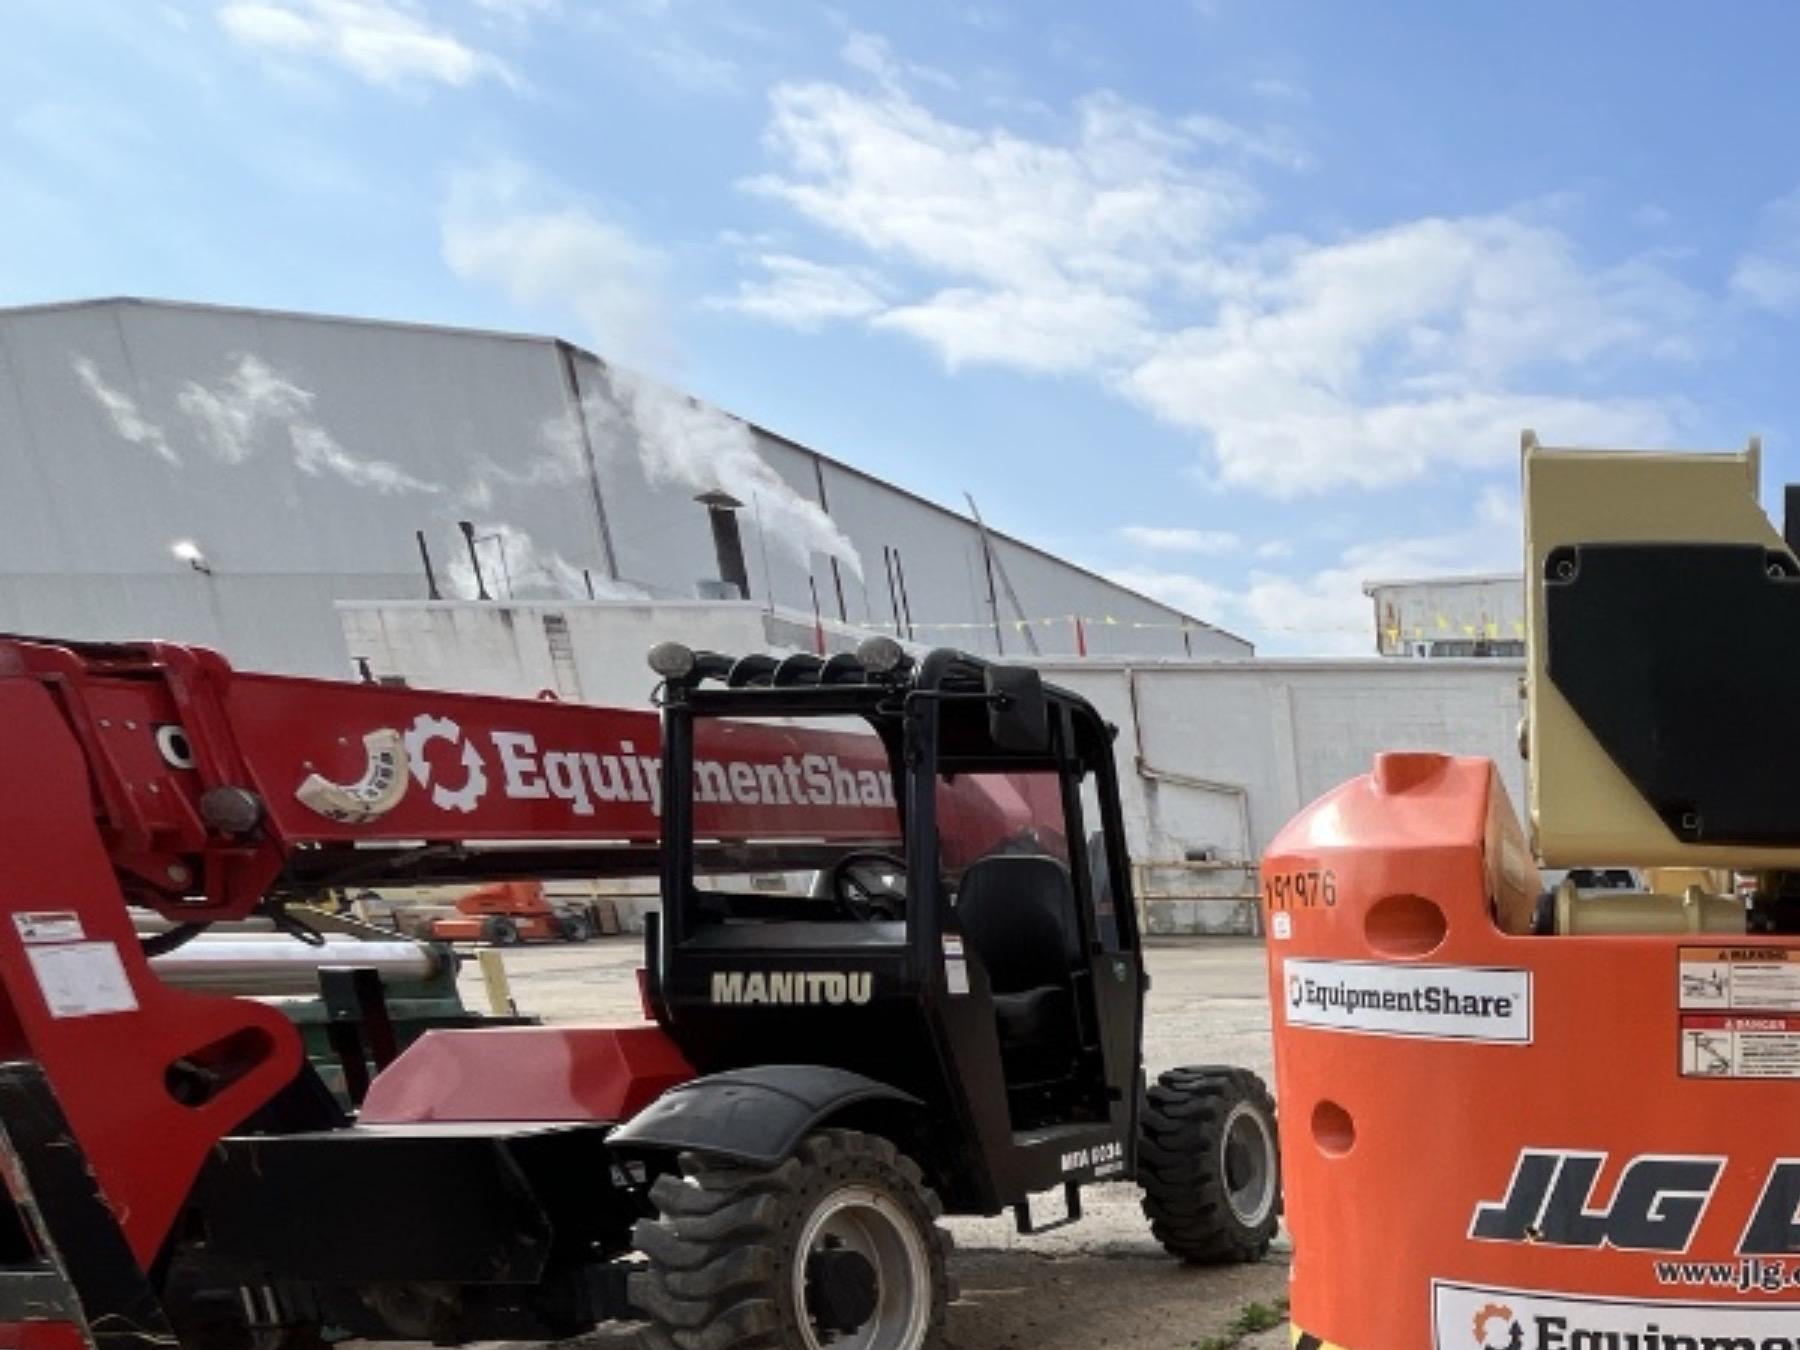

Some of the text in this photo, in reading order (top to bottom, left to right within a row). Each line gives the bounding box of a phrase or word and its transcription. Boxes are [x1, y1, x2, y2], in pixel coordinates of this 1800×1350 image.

[492, 731, 898, 820] EquimentShar
[710, 971, 873, 1006] MANITOU
[1304, 980, 1513, 1018] EquipmentShare
[1467, 1148, 1728, 1254] JLG
